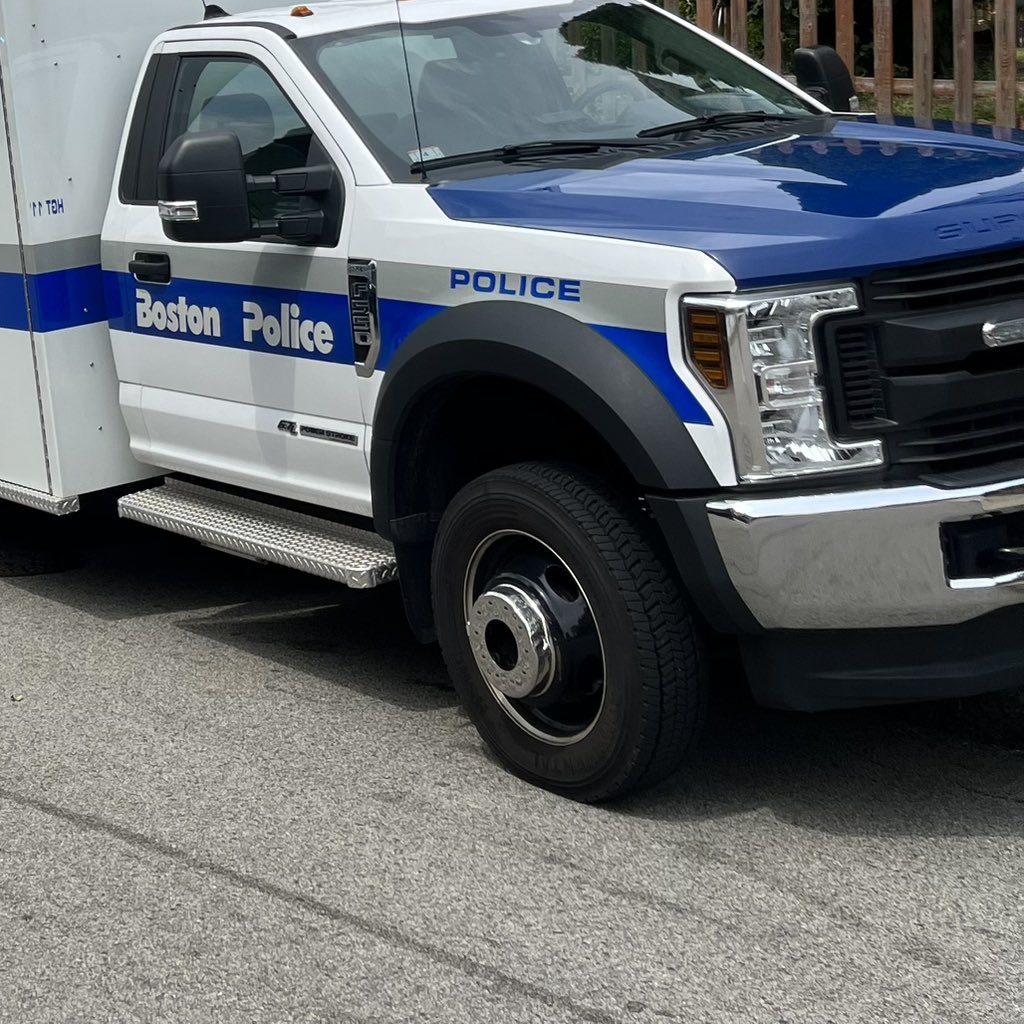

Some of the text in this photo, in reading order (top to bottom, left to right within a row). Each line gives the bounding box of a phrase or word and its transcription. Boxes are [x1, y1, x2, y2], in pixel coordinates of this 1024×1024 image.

[450, 268, 581, 303] POLICE
[135, 288, 334, 355] Boston Police
